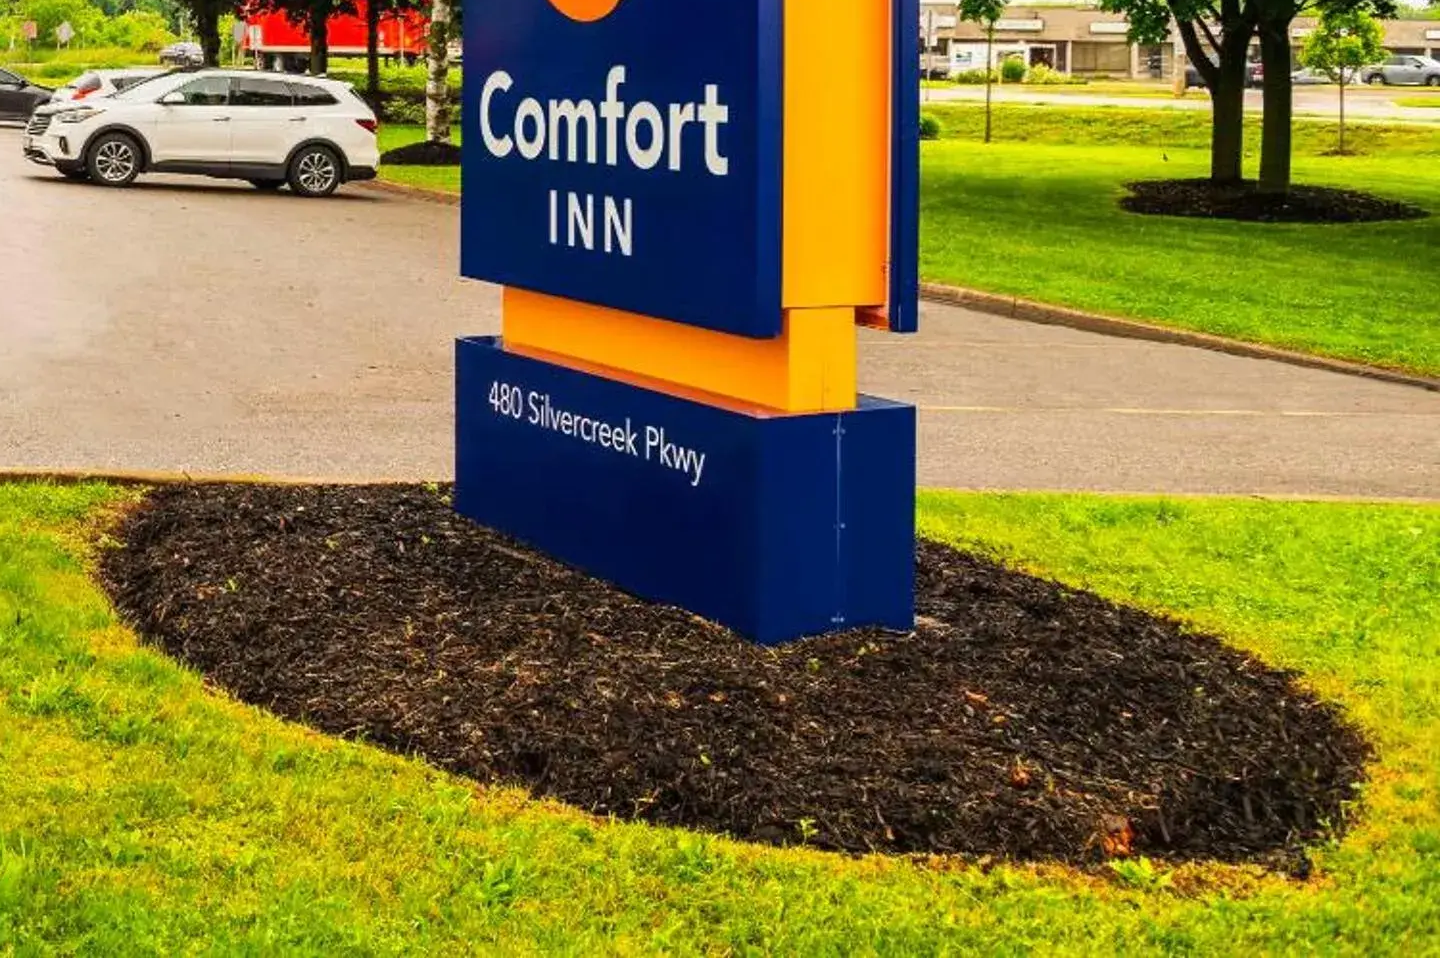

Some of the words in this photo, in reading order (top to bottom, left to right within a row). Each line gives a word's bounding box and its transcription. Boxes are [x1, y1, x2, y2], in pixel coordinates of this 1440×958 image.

[479, 64, 729, 176] Comfort
[549, 189, 633, 257] INN
[488, 380, 523, 420] 480
[527, 390, 639, 457] Silvercreek
[645, 425, 706, 487] Pkwy
